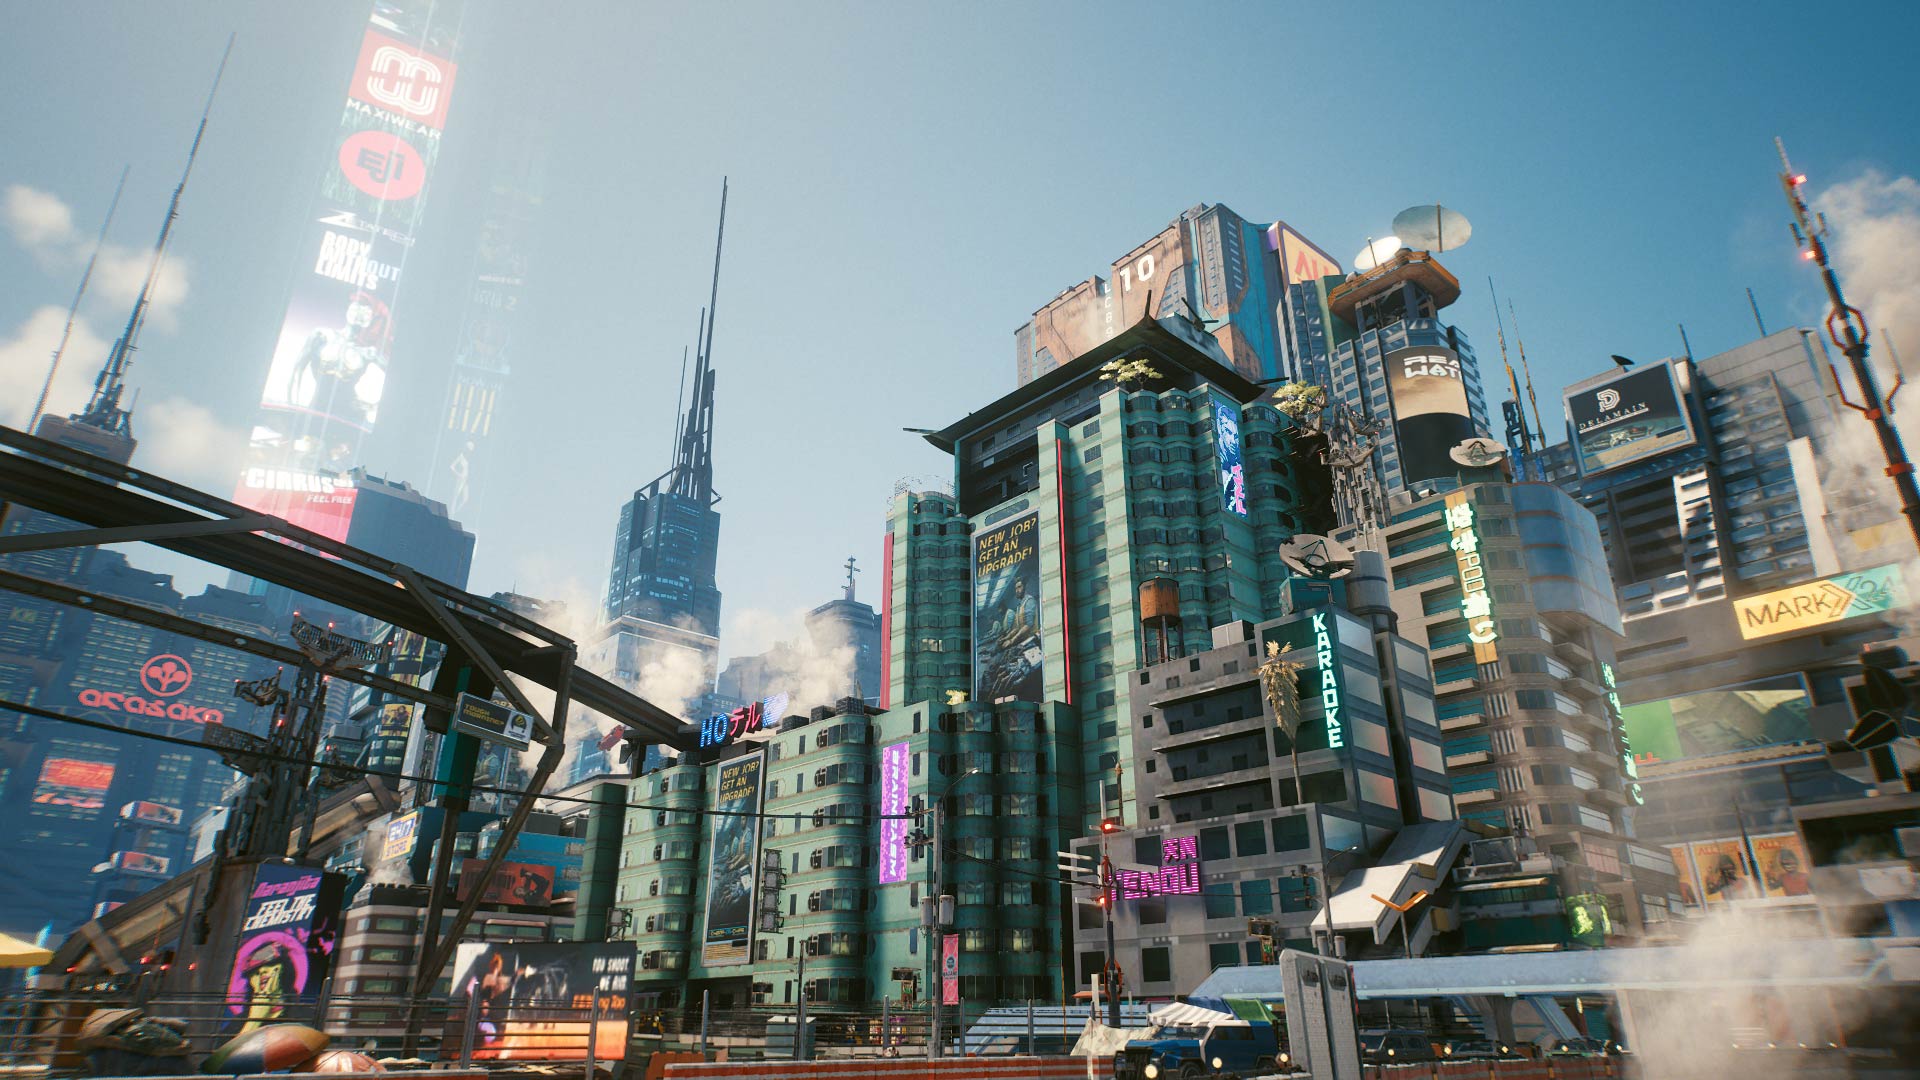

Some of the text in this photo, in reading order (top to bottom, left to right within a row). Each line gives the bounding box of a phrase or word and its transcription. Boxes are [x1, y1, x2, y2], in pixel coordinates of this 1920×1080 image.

[346, 98, 441, 140] MAXIWEAR
[320, 230, 371, 257] BODY
[314, 259, 379, 290] LIMITS
[1120, 254, 1154, 292] 10
[1579, 402, 1646, 430] DELAMAIN
[246, 467, 335, 494] CIRRUS
[980, 517, 1037, 550] NEW JOB?
[978, 546, 1032, 577] UPGRADE!
[979, 537, 1018, 563] GET AN
[1744, 592, 1832, 628] MARK
[1313, 613, 1344, 749] KARAOKE
[78, 689, 224, 724] arasaka
[721, 775, 747, 791] GET AN
[722, 761, 760, 779] NEW JOB?
[720, 786, 755, 803] UPGRADE!
[242, 905, 316, 932] CHEMISTRY
[256, 893, 317, 918] FEEL THE
